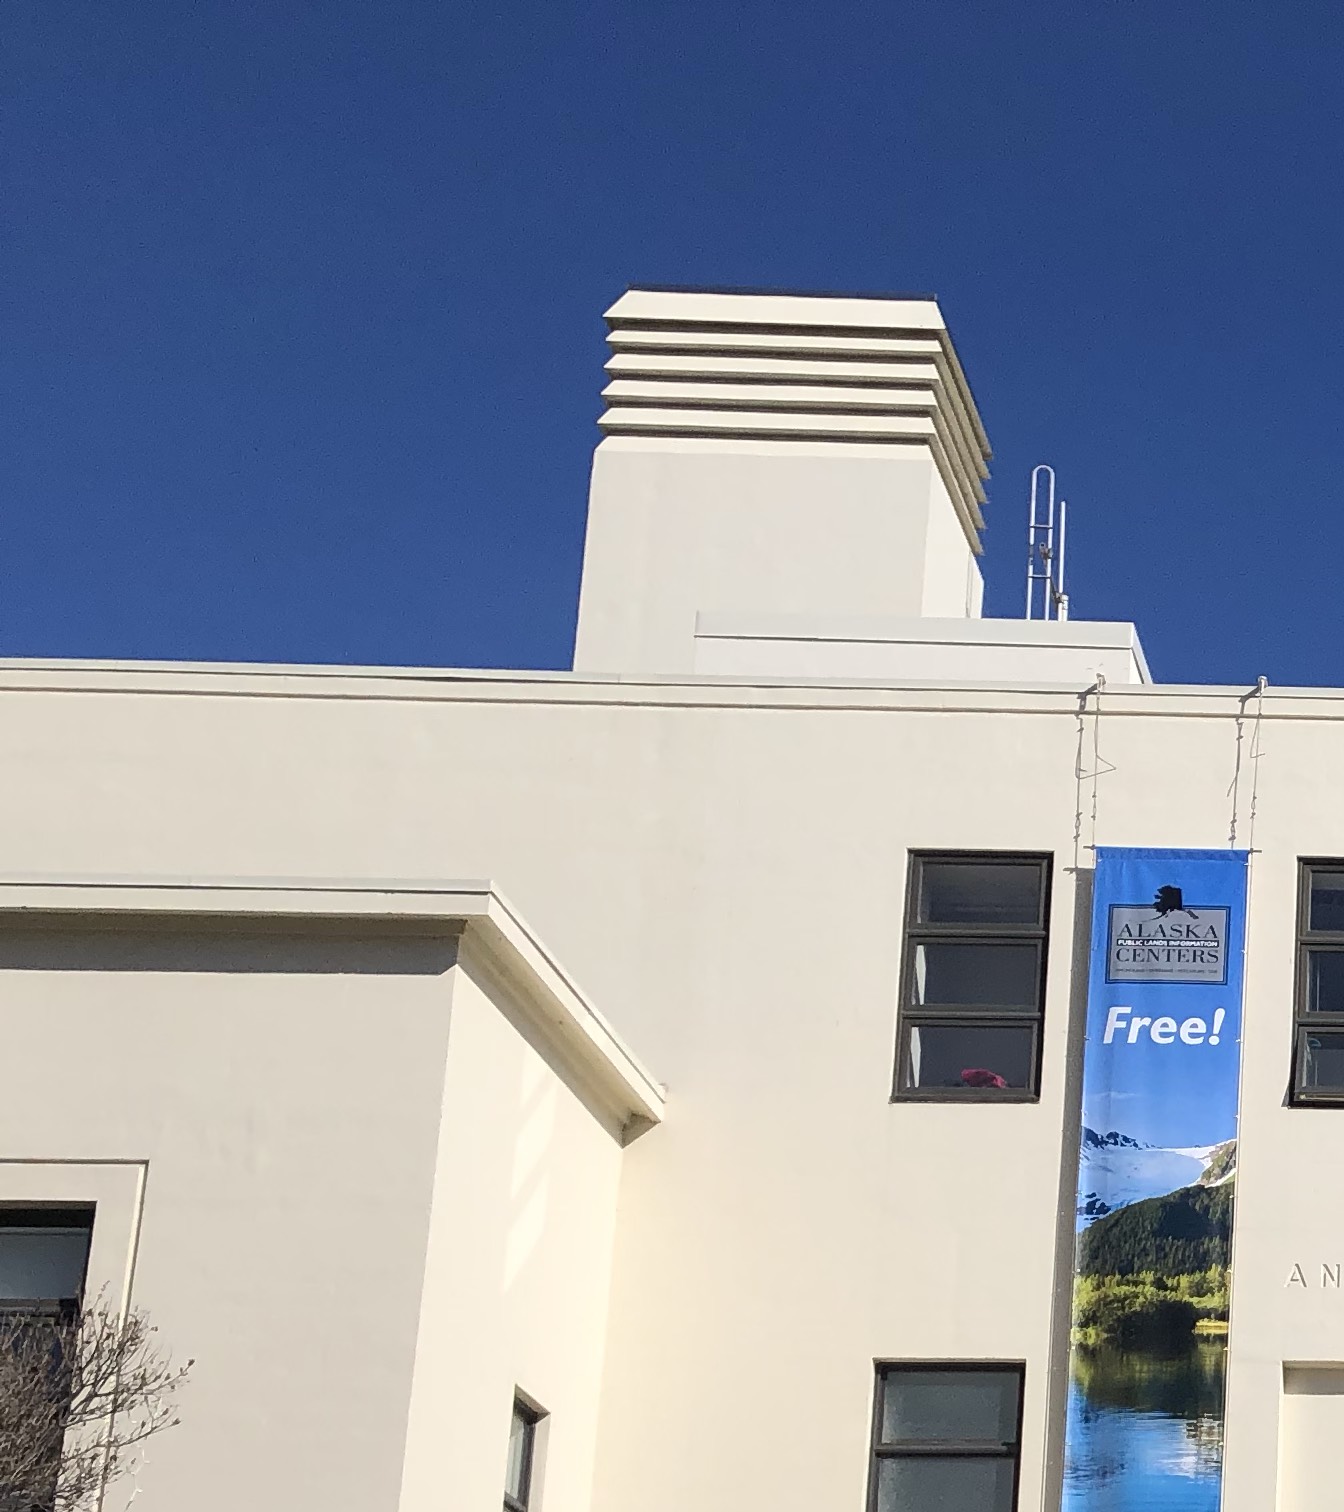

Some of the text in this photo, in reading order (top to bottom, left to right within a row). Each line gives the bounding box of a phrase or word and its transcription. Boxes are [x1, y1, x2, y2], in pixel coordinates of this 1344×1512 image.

[1118, 923, 1218, 939] ALASKA
[1117, 939, 1143, 947] PUBLIC
[1168, 940, 1218, 948] INFORMATION
[1116, 948, 1219, 964] CENTERS
[1102, 1006, 1226, 1046] Free!
